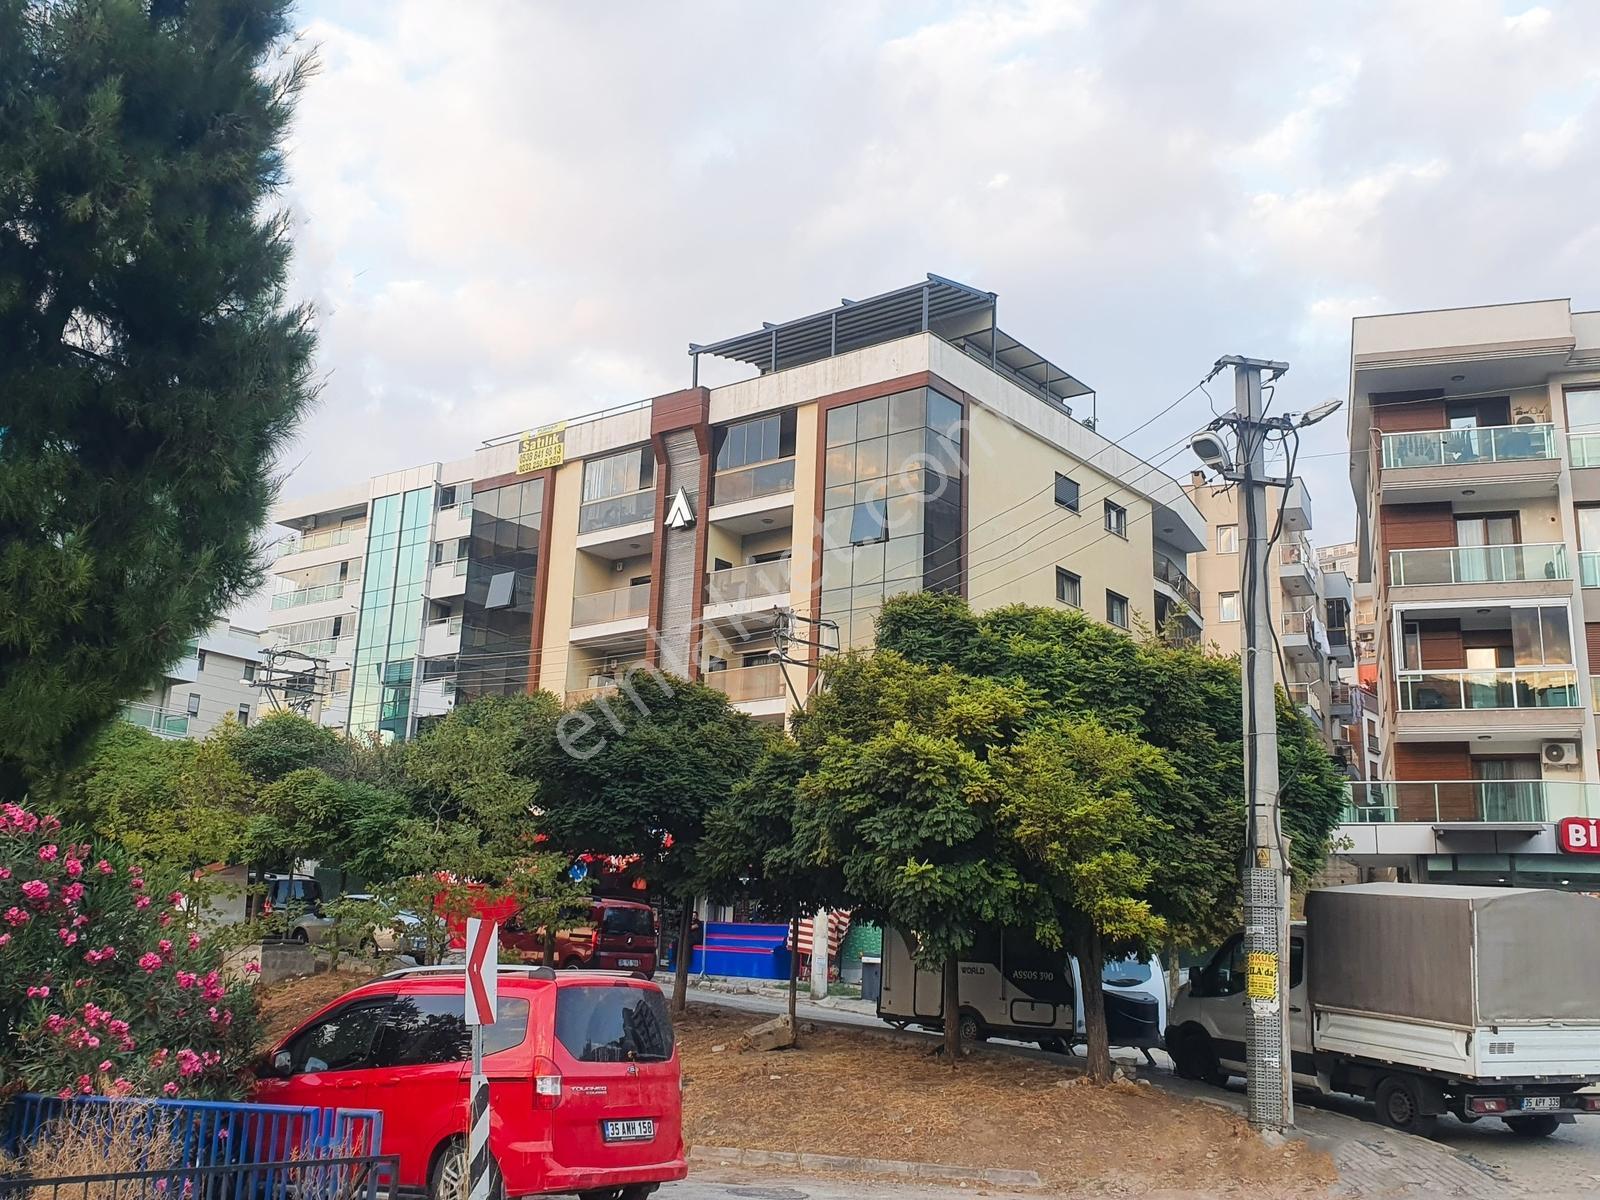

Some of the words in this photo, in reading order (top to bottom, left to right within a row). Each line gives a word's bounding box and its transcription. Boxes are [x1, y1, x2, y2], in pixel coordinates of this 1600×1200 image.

[522, 433, 560, 452] Satılık
[554, 445, 561, 455] 13
[961, 967, 985, 975] WORLD
[609, 1122, 620, 1136] 35
[638, 1121, 652, 1134] 158
